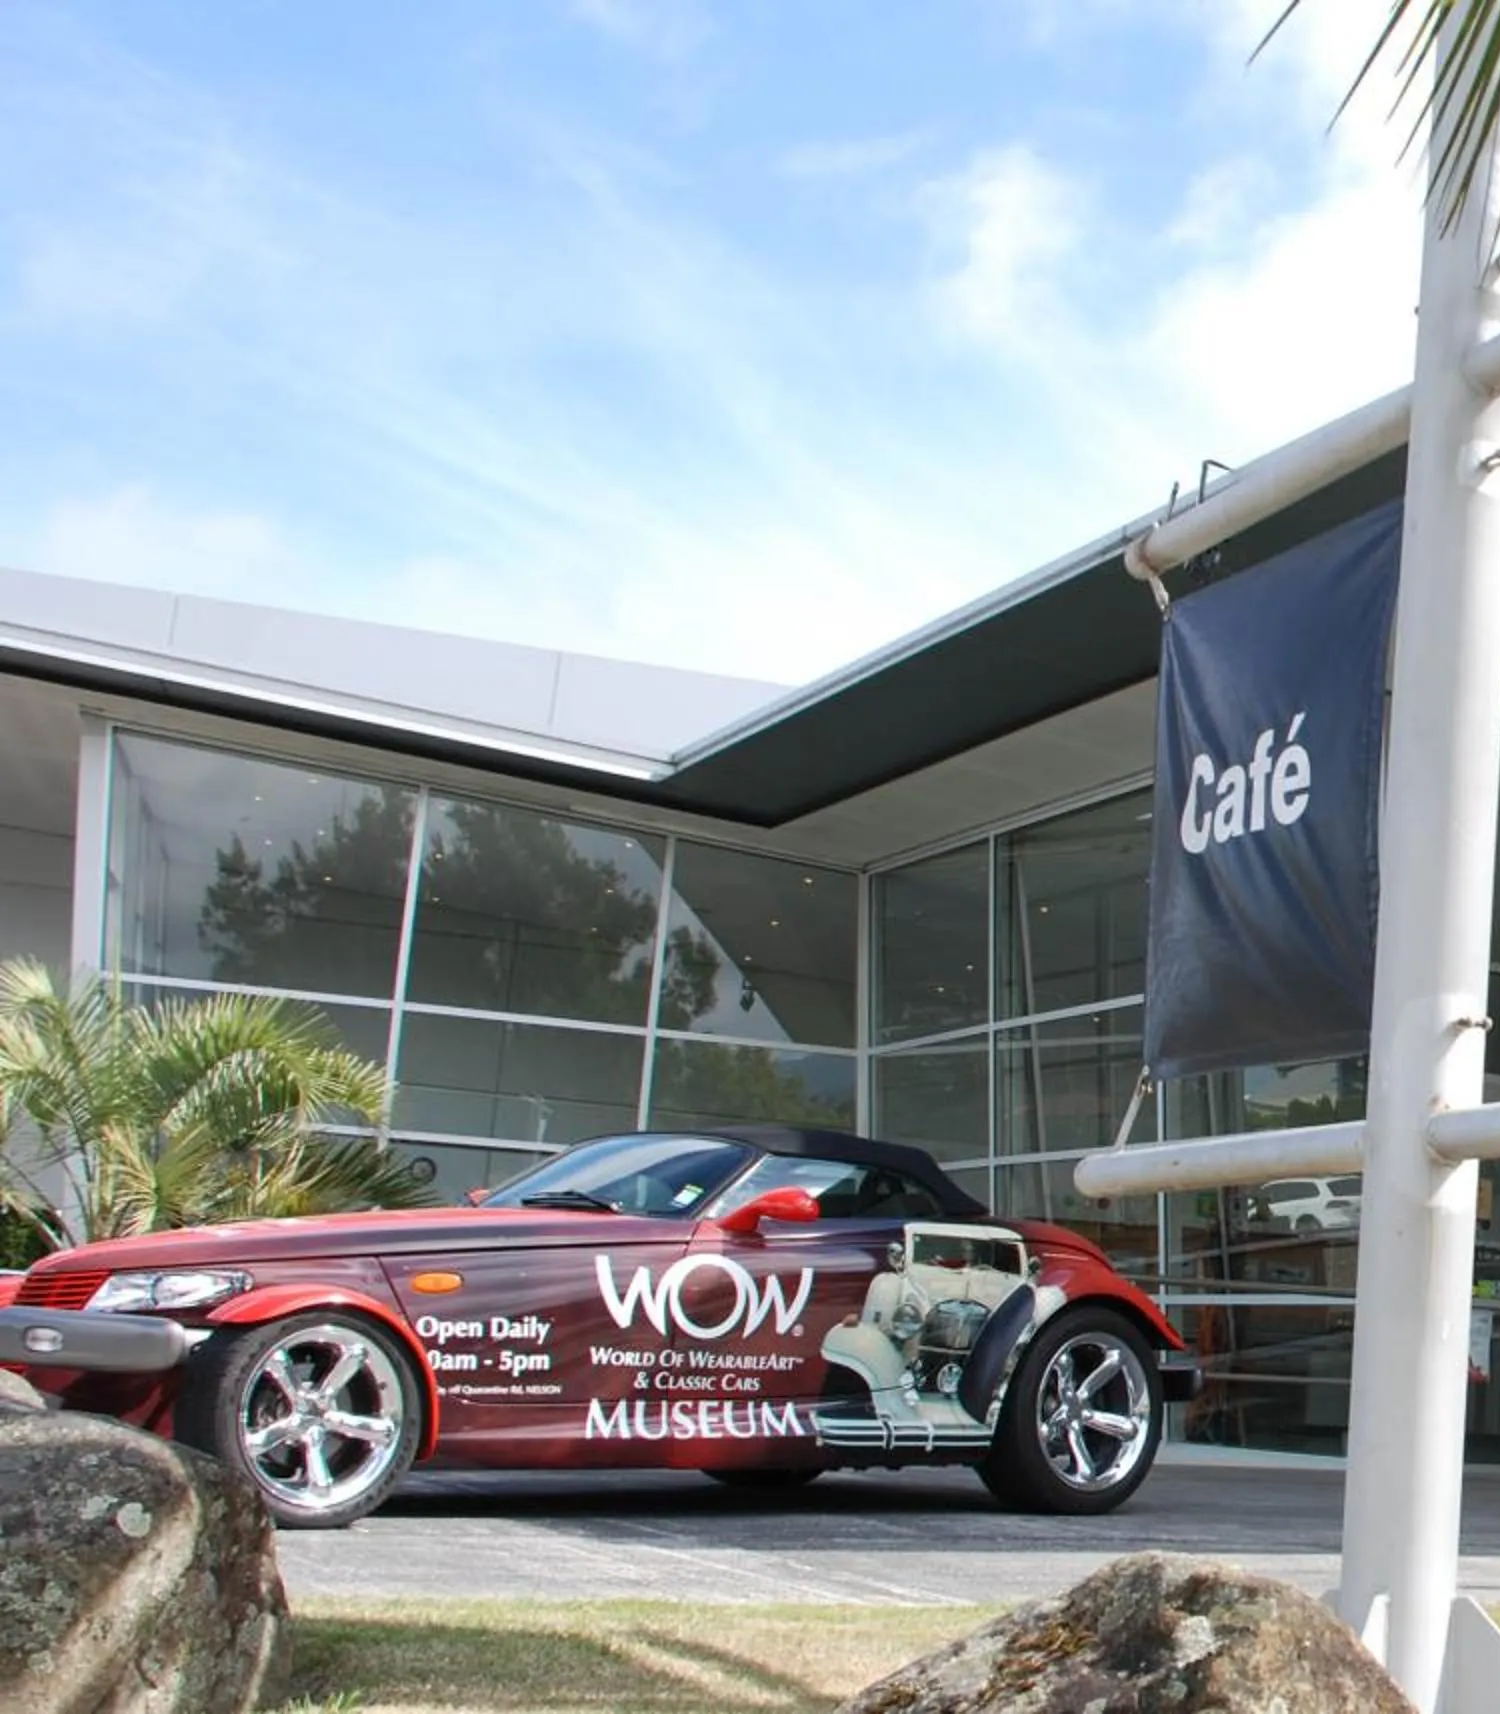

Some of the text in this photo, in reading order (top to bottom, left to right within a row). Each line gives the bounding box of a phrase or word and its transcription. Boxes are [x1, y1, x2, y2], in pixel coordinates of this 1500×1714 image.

[1180, 712, 1311, 853] Café
[594, 1253, 815, 1340] WOW
[415, 1316, 551, 1344] Open Daily
[426, 1349, 478, 1371] 0am
[498, 1351, 551, 1377] 5pm
[589, 1345, 654, 1367] WORLD
[659, 1349, 684, 1368] OF
[633, 1371, 761, 1391] & CLASSIC CARS
[585, 1398, 805, 1440] MUSEUM
